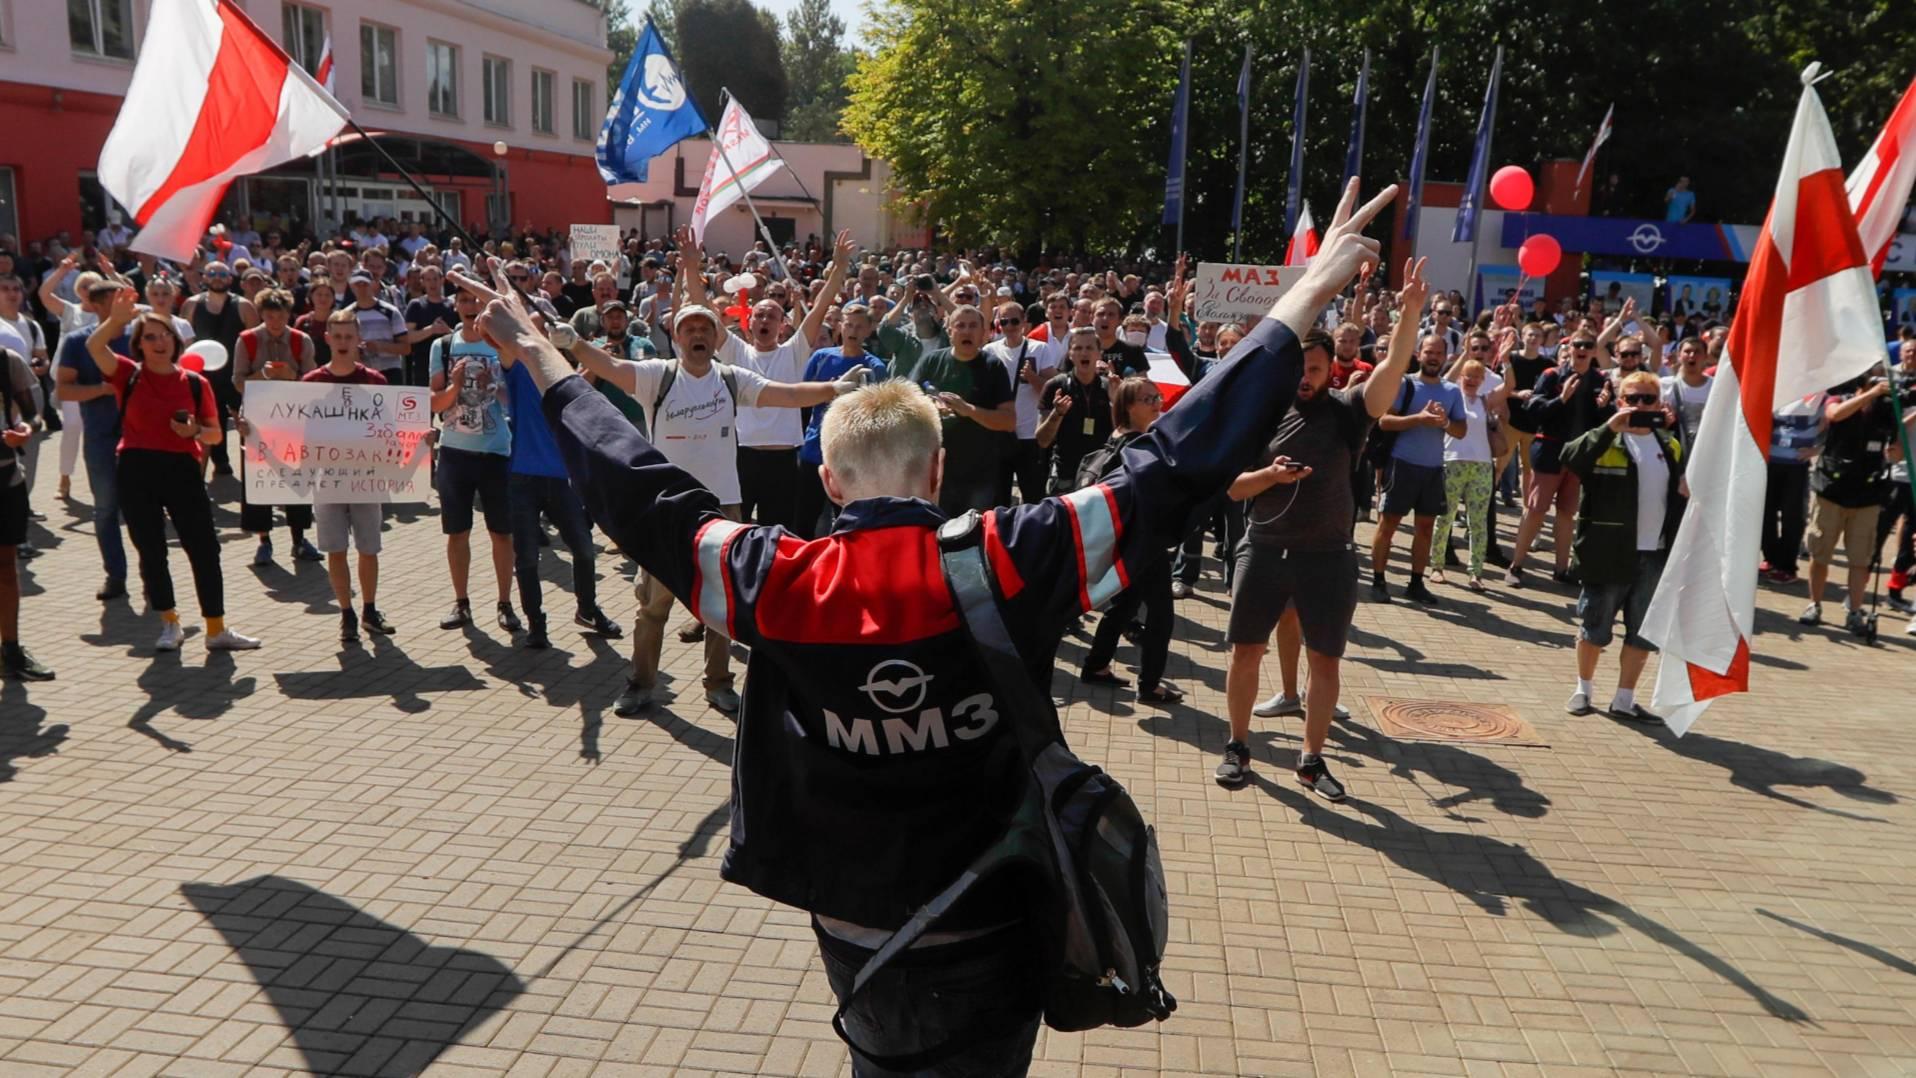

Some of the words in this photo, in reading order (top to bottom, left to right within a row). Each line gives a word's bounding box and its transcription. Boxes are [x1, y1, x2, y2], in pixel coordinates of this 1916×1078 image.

[1220, 267, 1280, 286] МАЗ
[257, 466, 376, 479] СЛЕДУЮЩИЙ
[255, 479, 343, 489] ПРЕДМЕТ
[350, 478, 415, 493] ИСТОРИЯ
[822, 693, 999, 755] ММЗ
